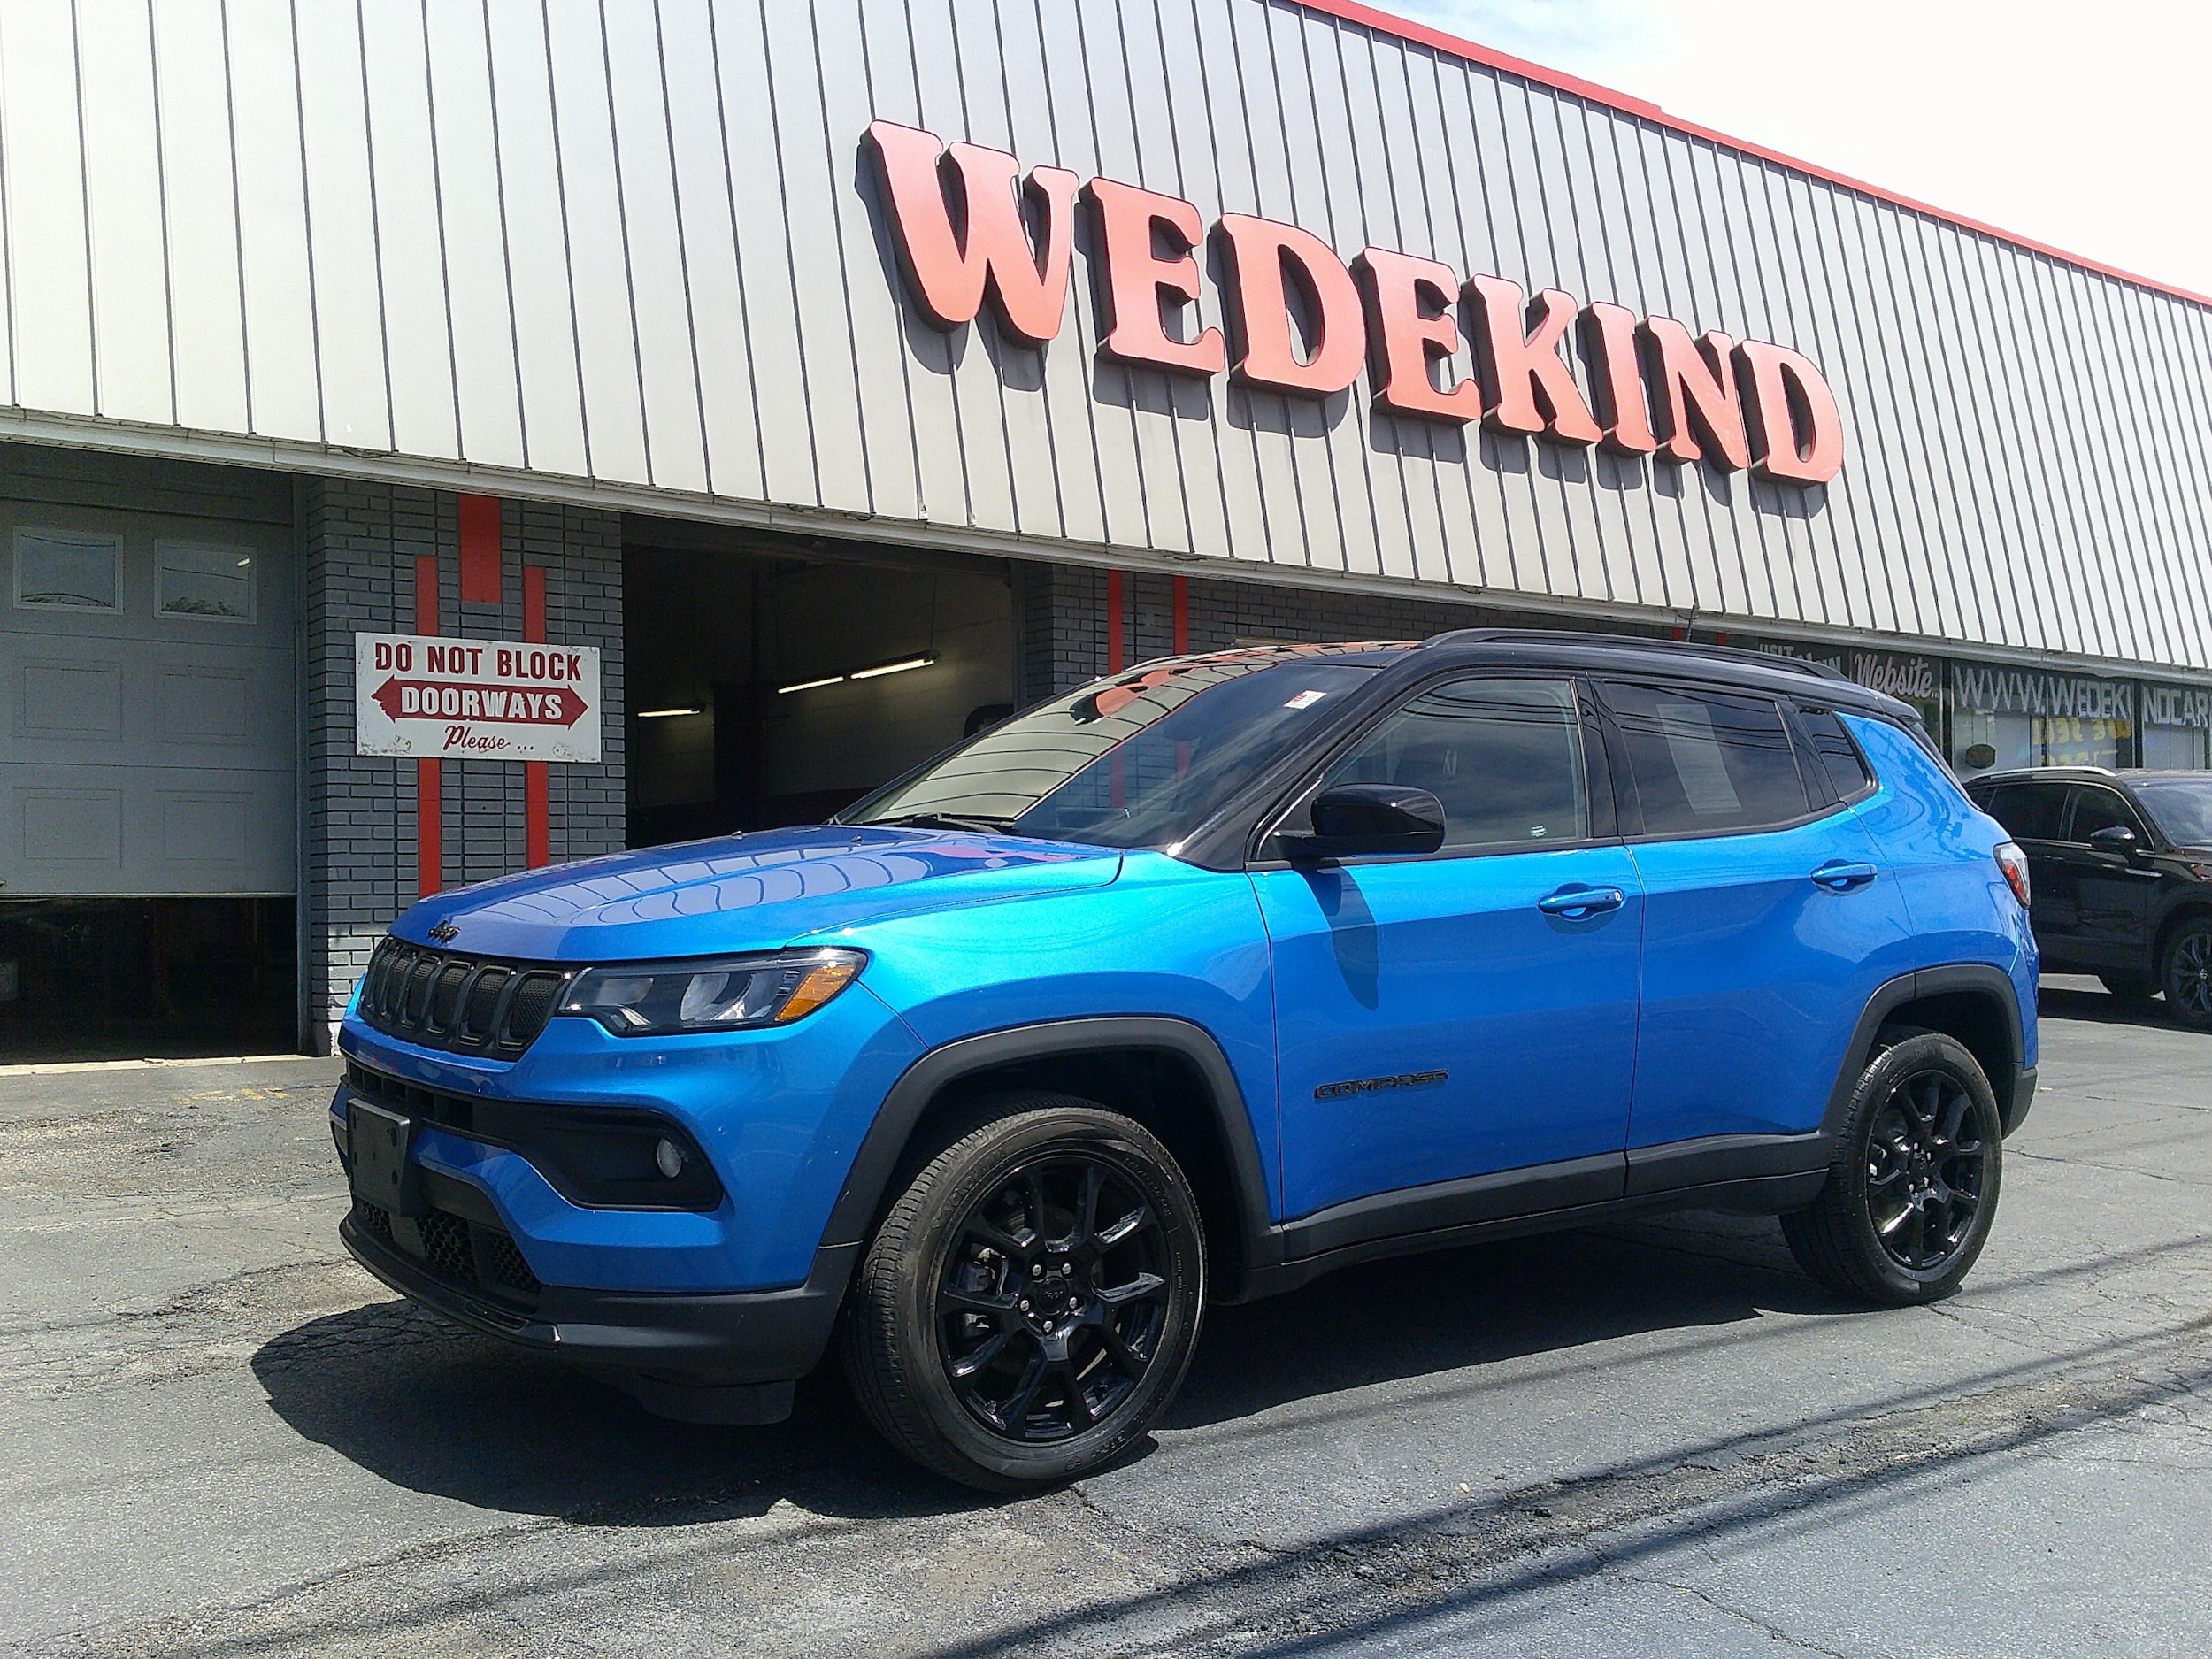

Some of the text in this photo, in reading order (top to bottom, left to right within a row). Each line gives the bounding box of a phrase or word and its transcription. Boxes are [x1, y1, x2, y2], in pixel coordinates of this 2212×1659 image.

[862, 119, 1845, 484] WEDEKIND
[374, 642, 583, 682] DO NOT BLOCK
[401, 687, 564, 720] DOORWAYS
[1314, 1069, 1449, 1099] COMPASS
